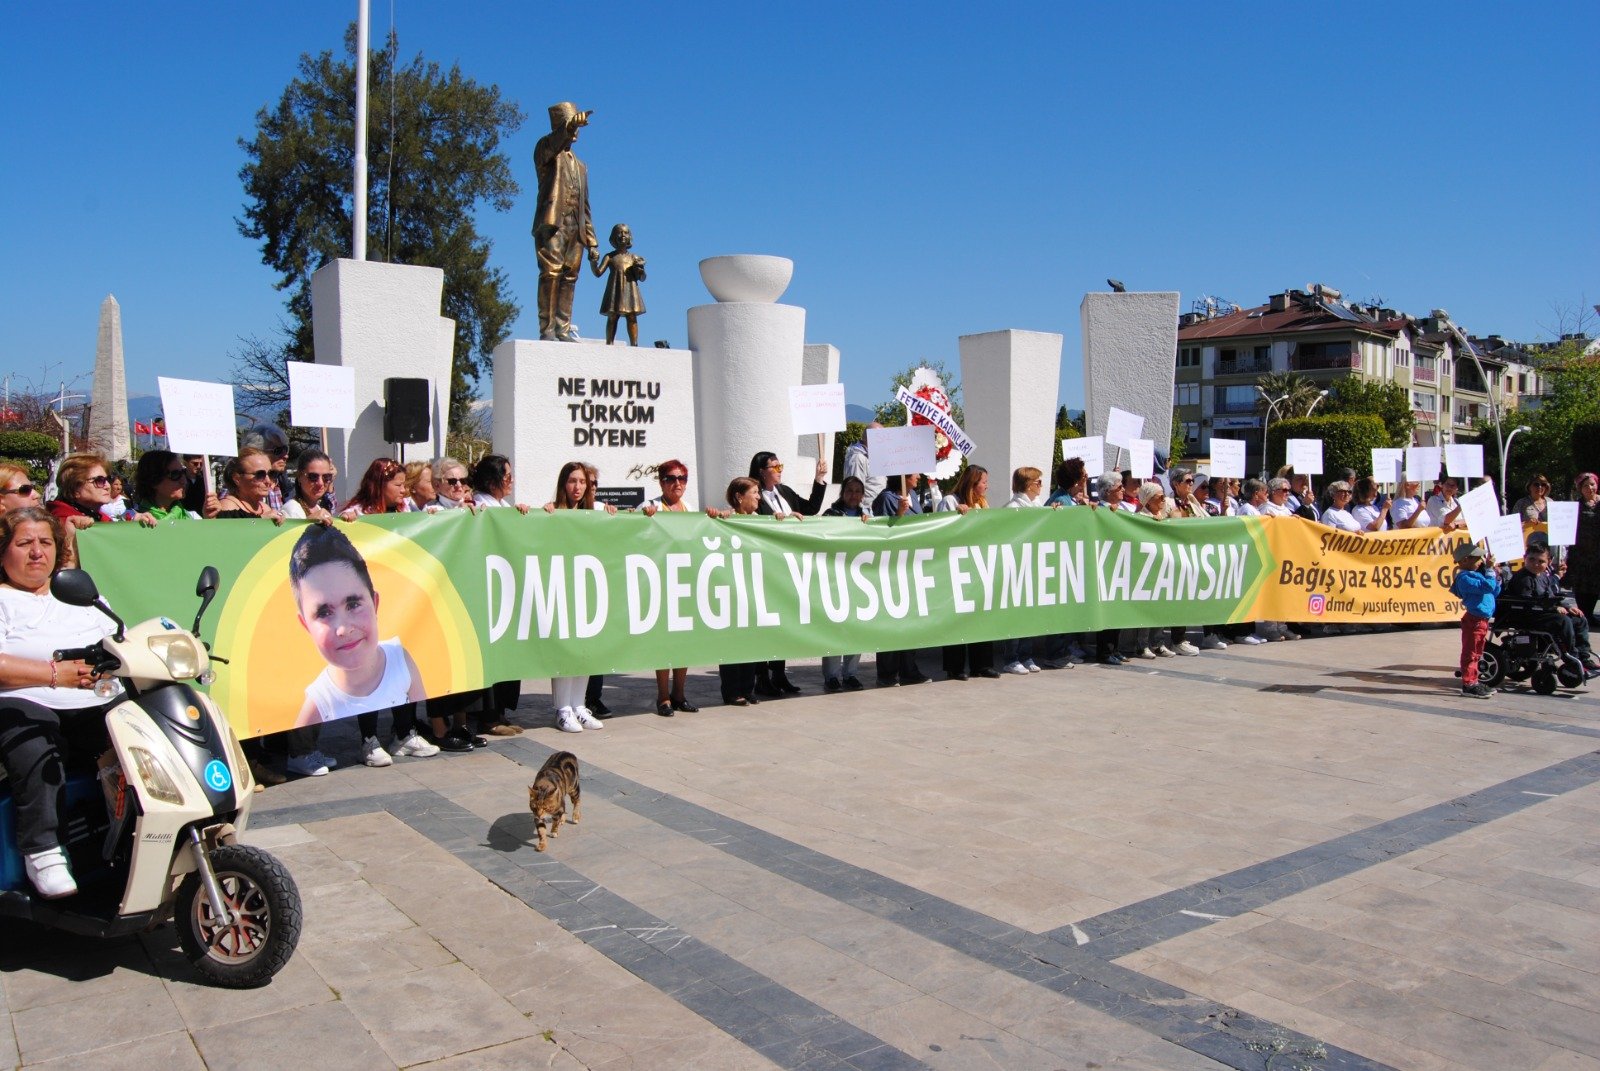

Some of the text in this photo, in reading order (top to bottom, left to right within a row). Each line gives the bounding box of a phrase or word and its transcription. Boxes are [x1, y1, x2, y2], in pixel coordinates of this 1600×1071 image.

[558, 377, 661, 400] NE MUTLU
[567, 399, 655, 424] TÜRKÜM
[900, 391, 939, 422] FETHİYE
[937, 416, 973, 456] KADINLARI
[573, 422, 647, 447] DİYENE
[1368, 538, 1421, 556] DESTEK
[1279, 559, 1336, 593] Bağış
[1338, 569, 1367, 594] yaz
[1371, 565, 1432, 589] 4854'e
[485, 535, 1249, 644] DMD DEĞİL YUSUF EYMEN KAZANSIN
